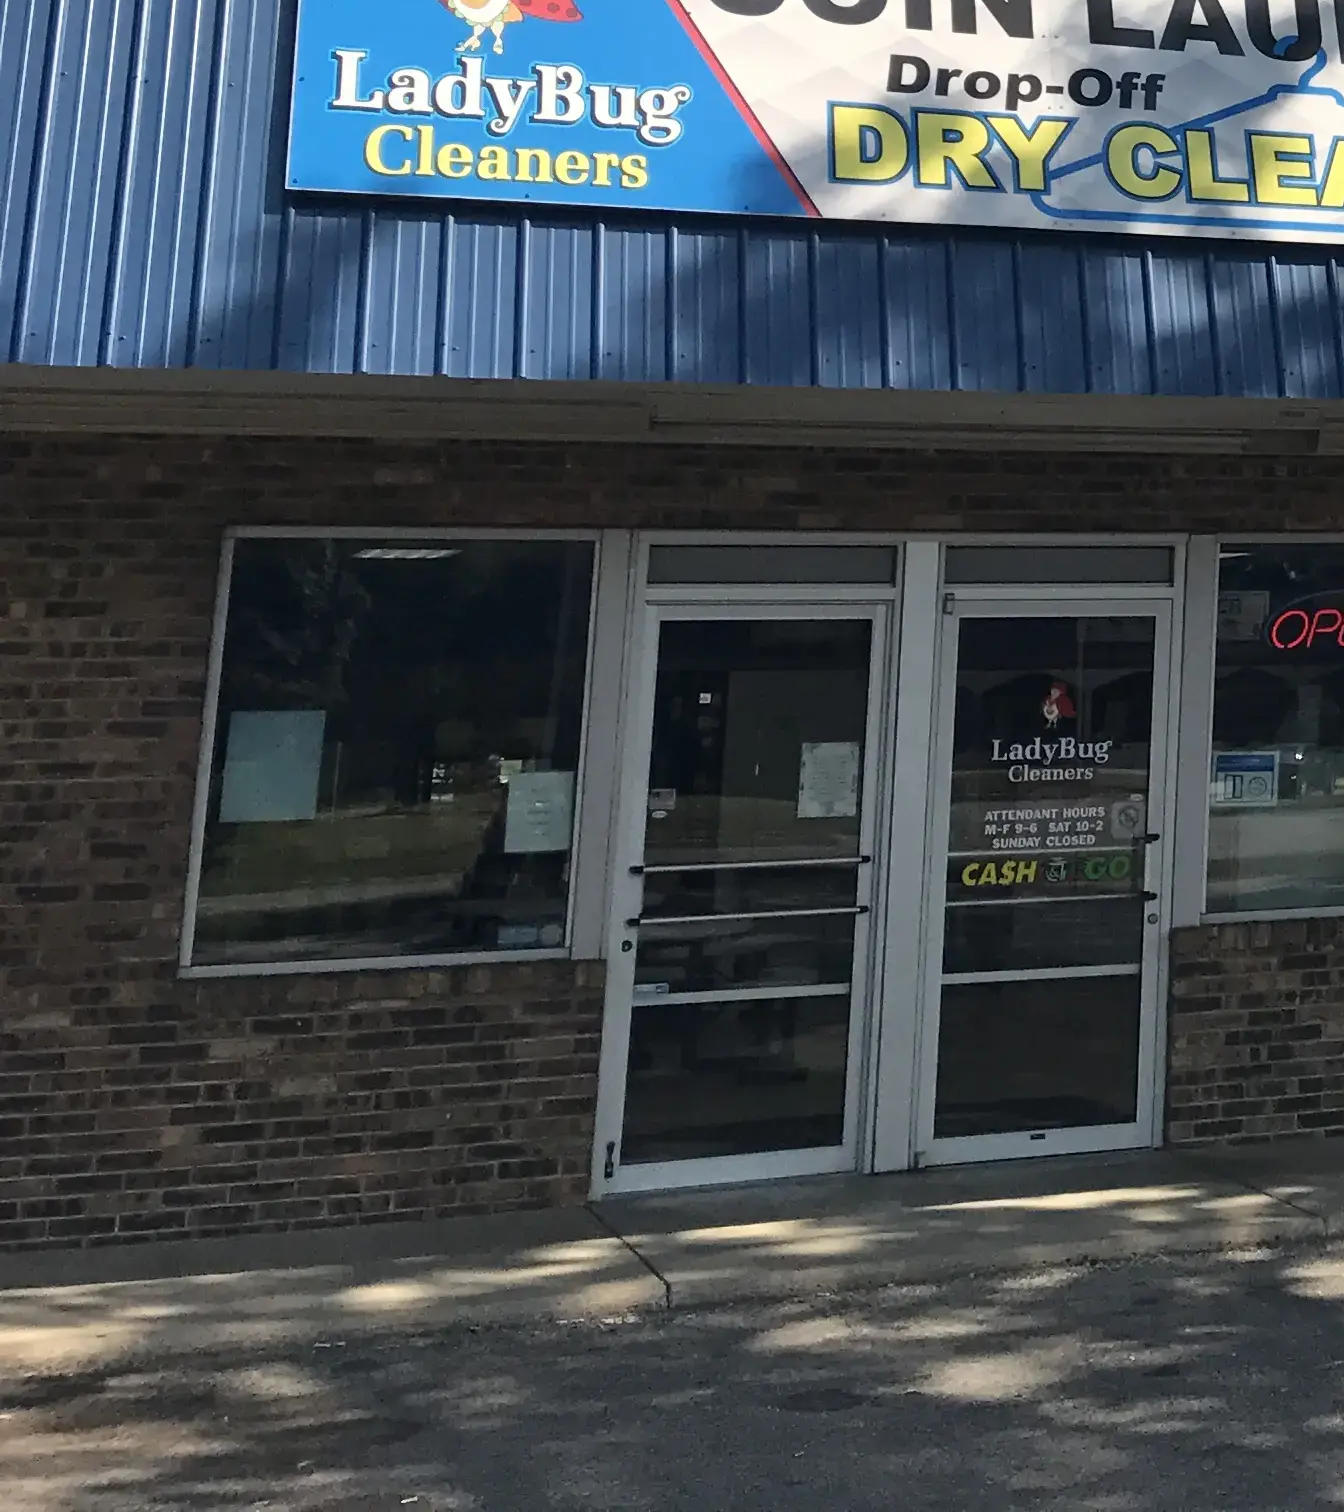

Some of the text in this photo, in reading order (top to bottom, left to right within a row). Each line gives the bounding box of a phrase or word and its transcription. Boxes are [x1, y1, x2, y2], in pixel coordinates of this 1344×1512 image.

[886, 54, 1166, 112] Drop-Off
[331, 48, 692, 146] LadyBug
[364, 124, 649, 189] Cleaners
[827, 100, 1077, 196] DRY
[991, 737, 1113, 765] LadyBug
[1007, 763, 1094, 784] Cleaners
[984, 806, 1106, 822] ATTENDANT HOURS
[984, 820, 1104, 836] M-F 9-6 SAT 10-2
[991, 834, 1096, 849] SUNDAY CLOSED
[1084, 855, 1131, 880] GO
